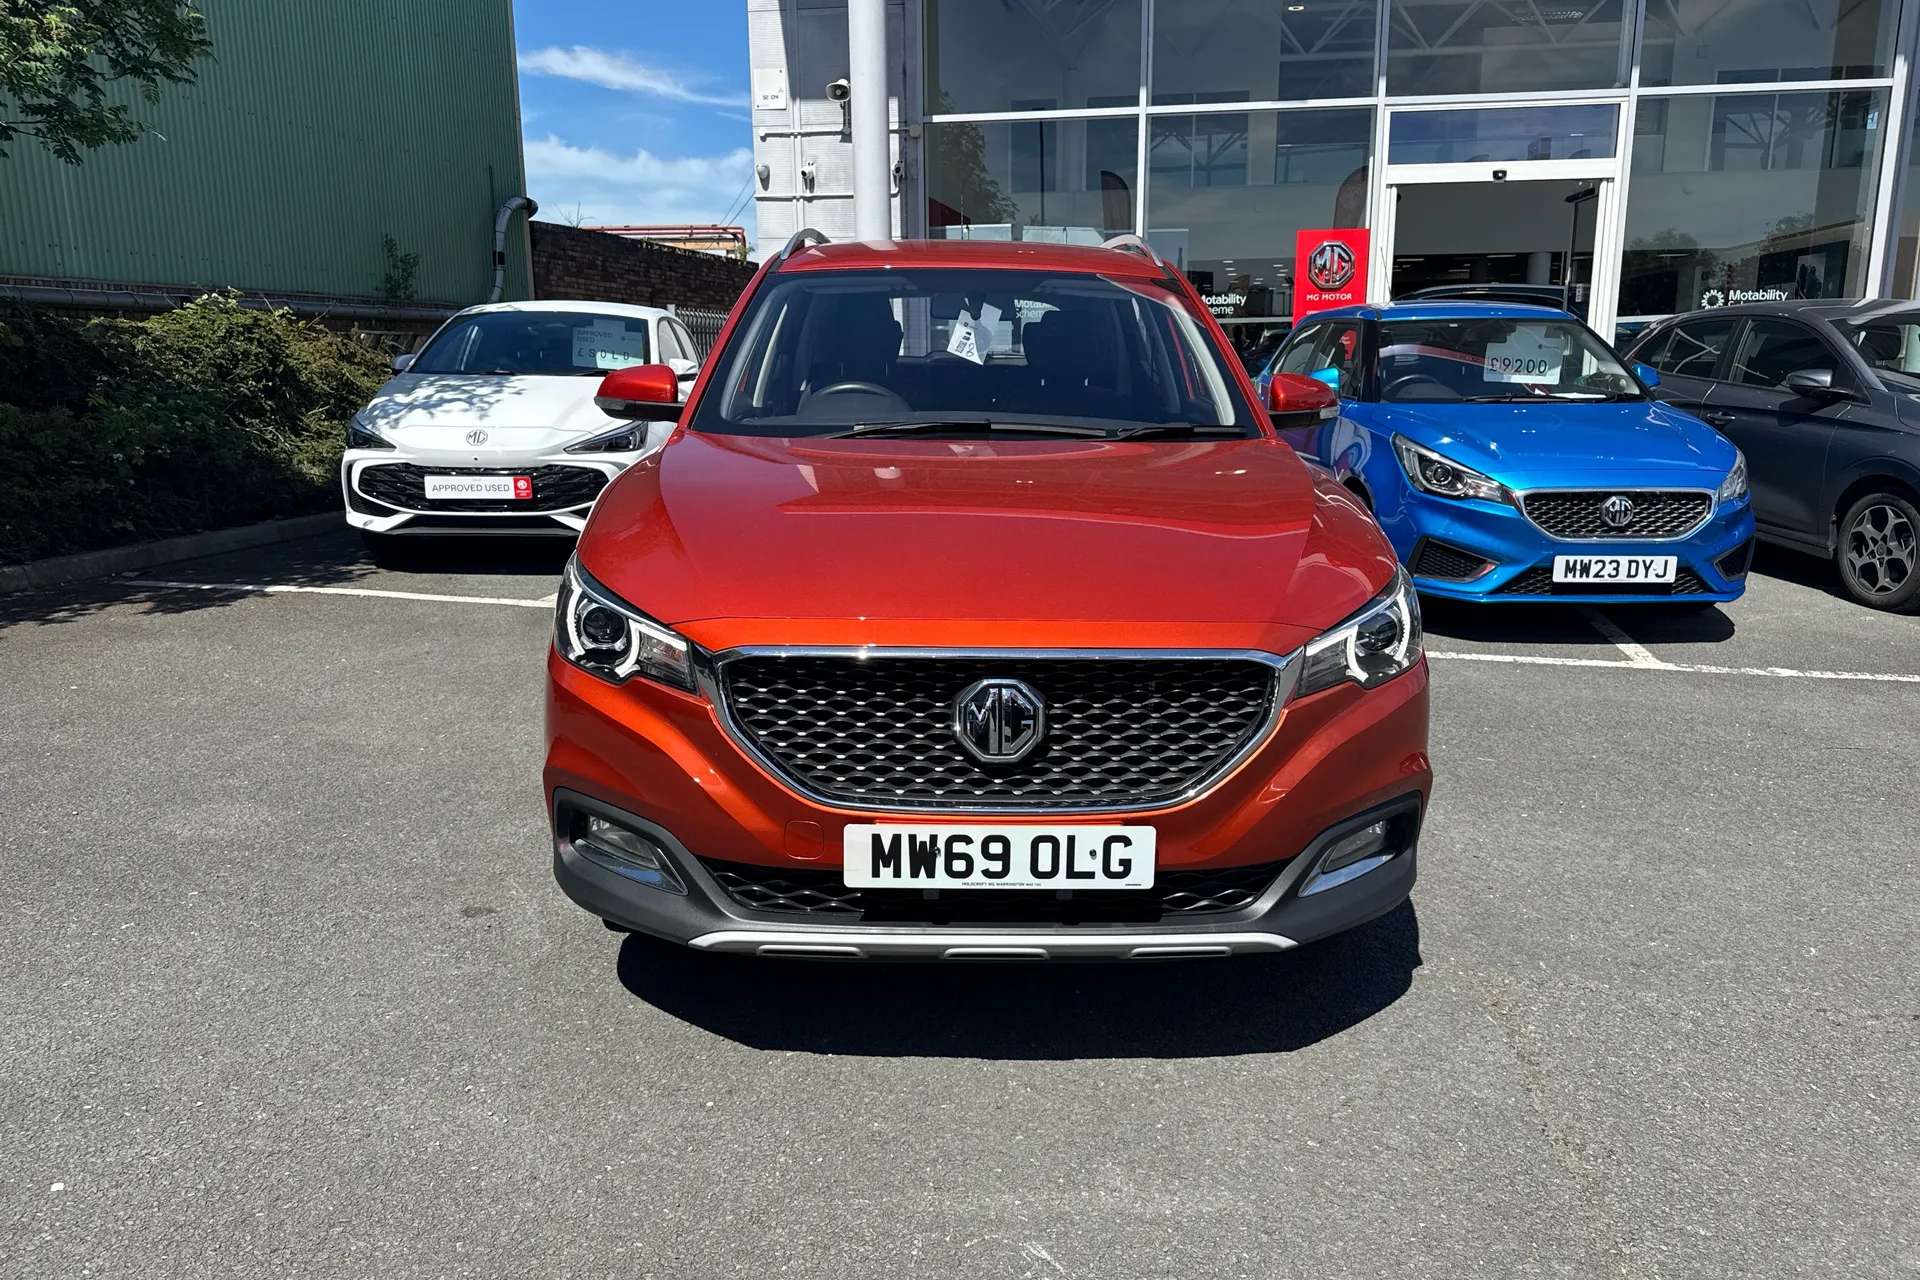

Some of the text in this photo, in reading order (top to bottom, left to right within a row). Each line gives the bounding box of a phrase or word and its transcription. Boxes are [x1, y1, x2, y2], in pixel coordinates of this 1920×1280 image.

[1312, 244, 1352, 284] MG
[1322, 293, 1352, 301] MOTOR
[1728, 289, 1788, 301] Motability
[1489, 357, 1548, 374] £9200
[466, 430, 487, 445] MG
[432, 484, 483, 493] APPROVED
[485, 484, 510, 493] USED
[1606, 498, 1632, 525] MG
[1563, 559, 1669, 579] MW23 DYJ
[961, 684, 1038, 757] MG
[871, 833, 1133, 880] MW69 OLG
